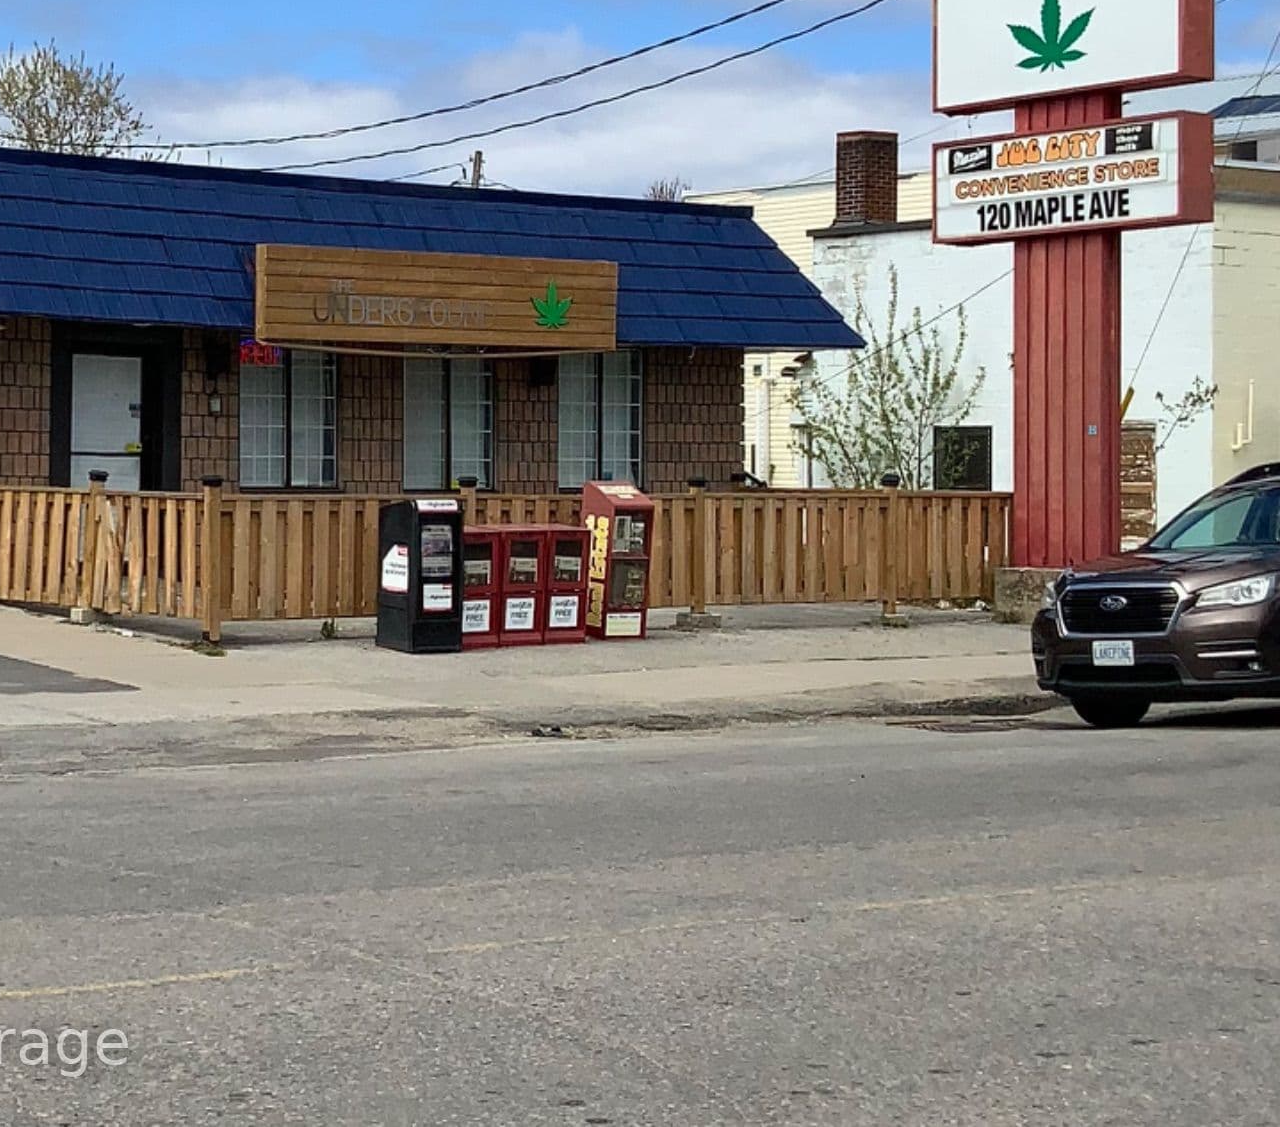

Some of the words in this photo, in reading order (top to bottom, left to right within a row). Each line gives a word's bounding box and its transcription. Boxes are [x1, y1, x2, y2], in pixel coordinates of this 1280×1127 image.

[996, 136, 1041, 167] JUG
[1045, 131, 1101, 162] CITY
[956, 167, 1089, 200] CONVENIENCE
[1093, 158, 1160, 184] STORE
[977, 202, 1011, 232] 120
[1015, 194, 1085, 228] MAPLE
[1089, 189, 1130, 220] AVE
